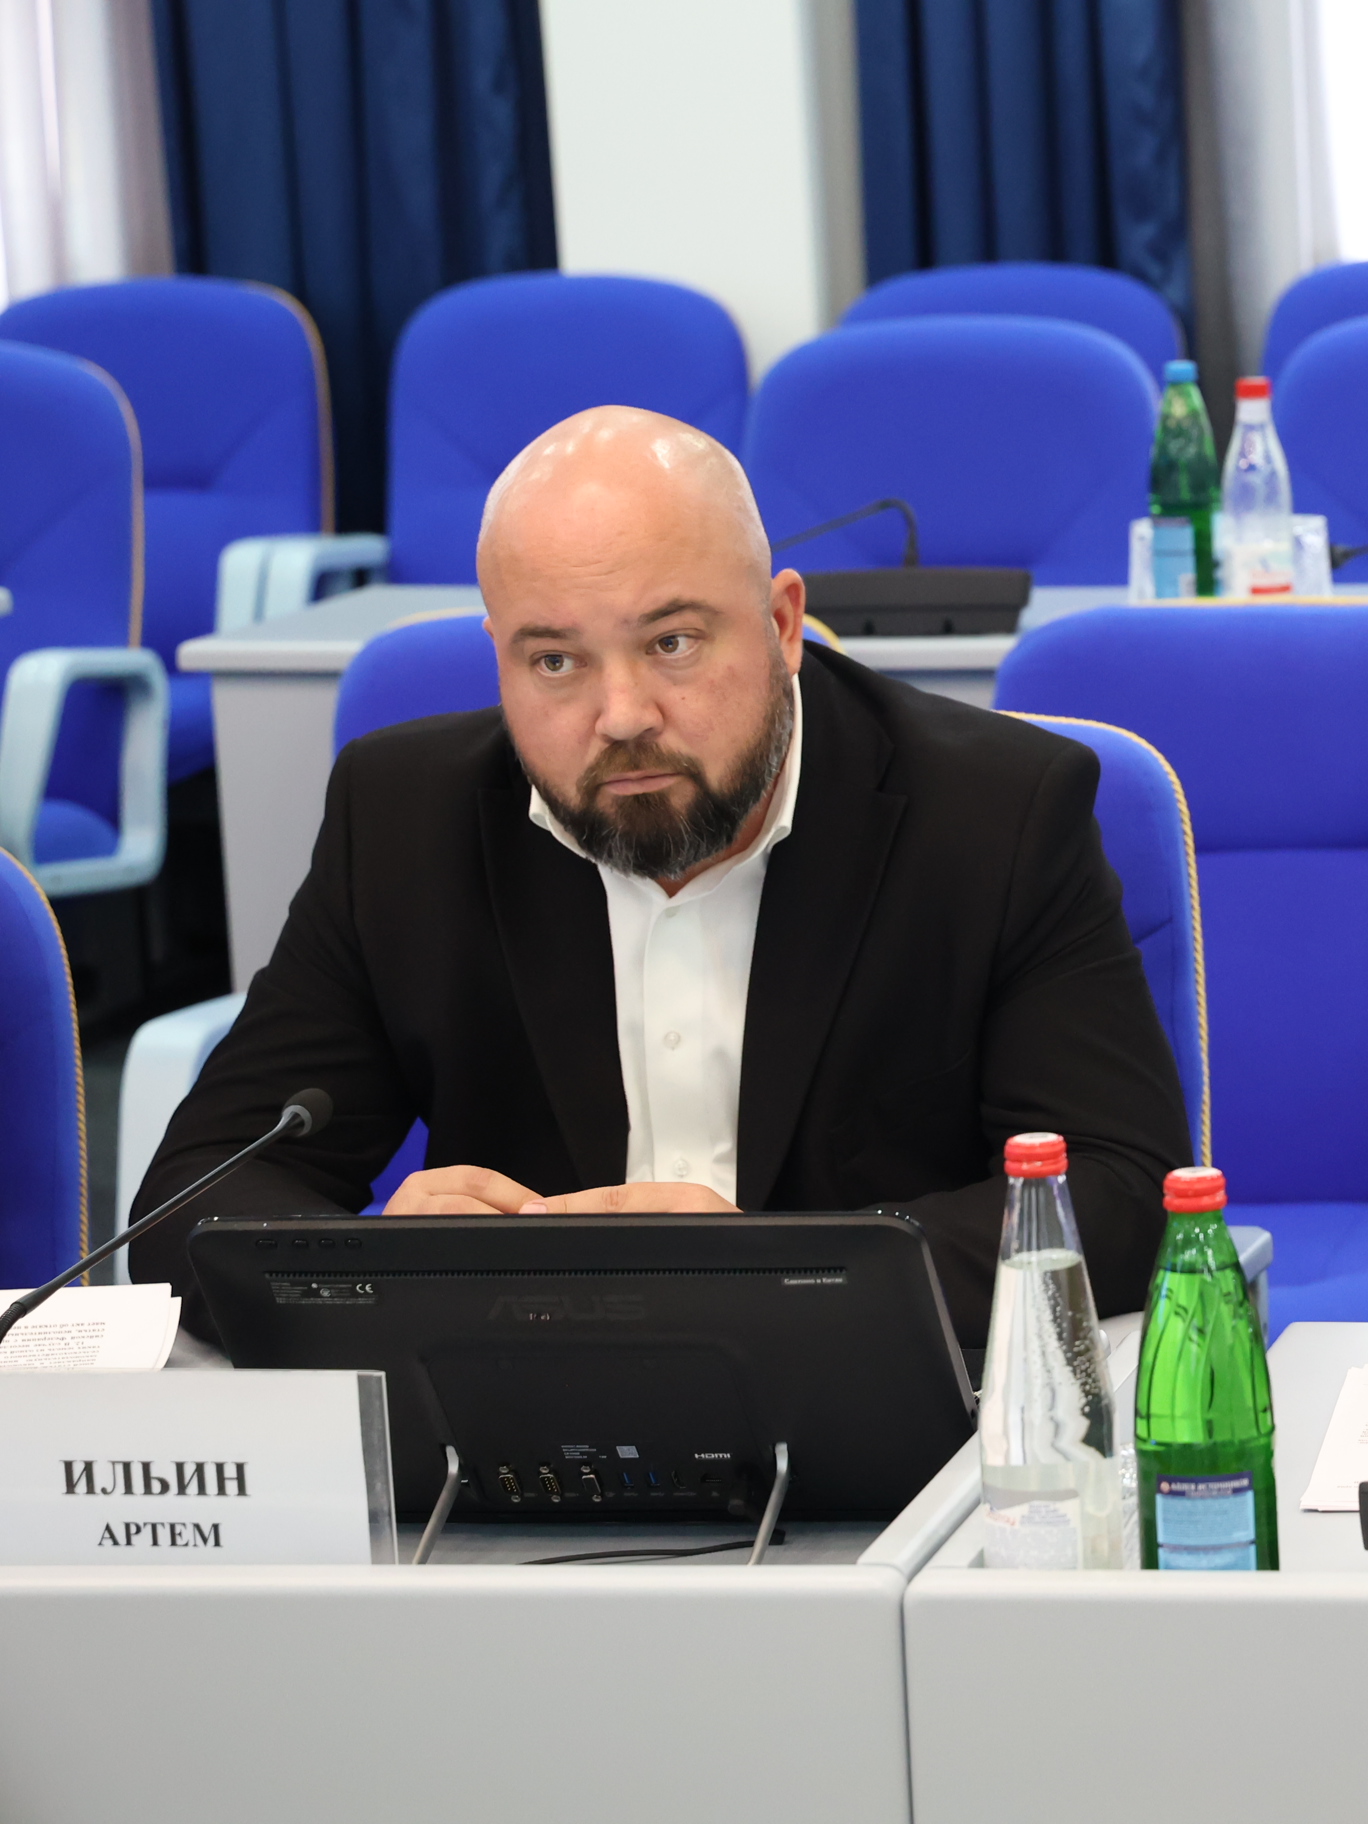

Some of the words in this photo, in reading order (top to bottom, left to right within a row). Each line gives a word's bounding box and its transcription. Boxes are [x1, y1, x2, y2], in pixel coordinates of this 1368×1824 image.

[487, 1295, 648, 1321] ASUS
[60, 1460, 250, 1497] ИЛЬИН
[97, 1522, 224, 1548] АРТЕМ
